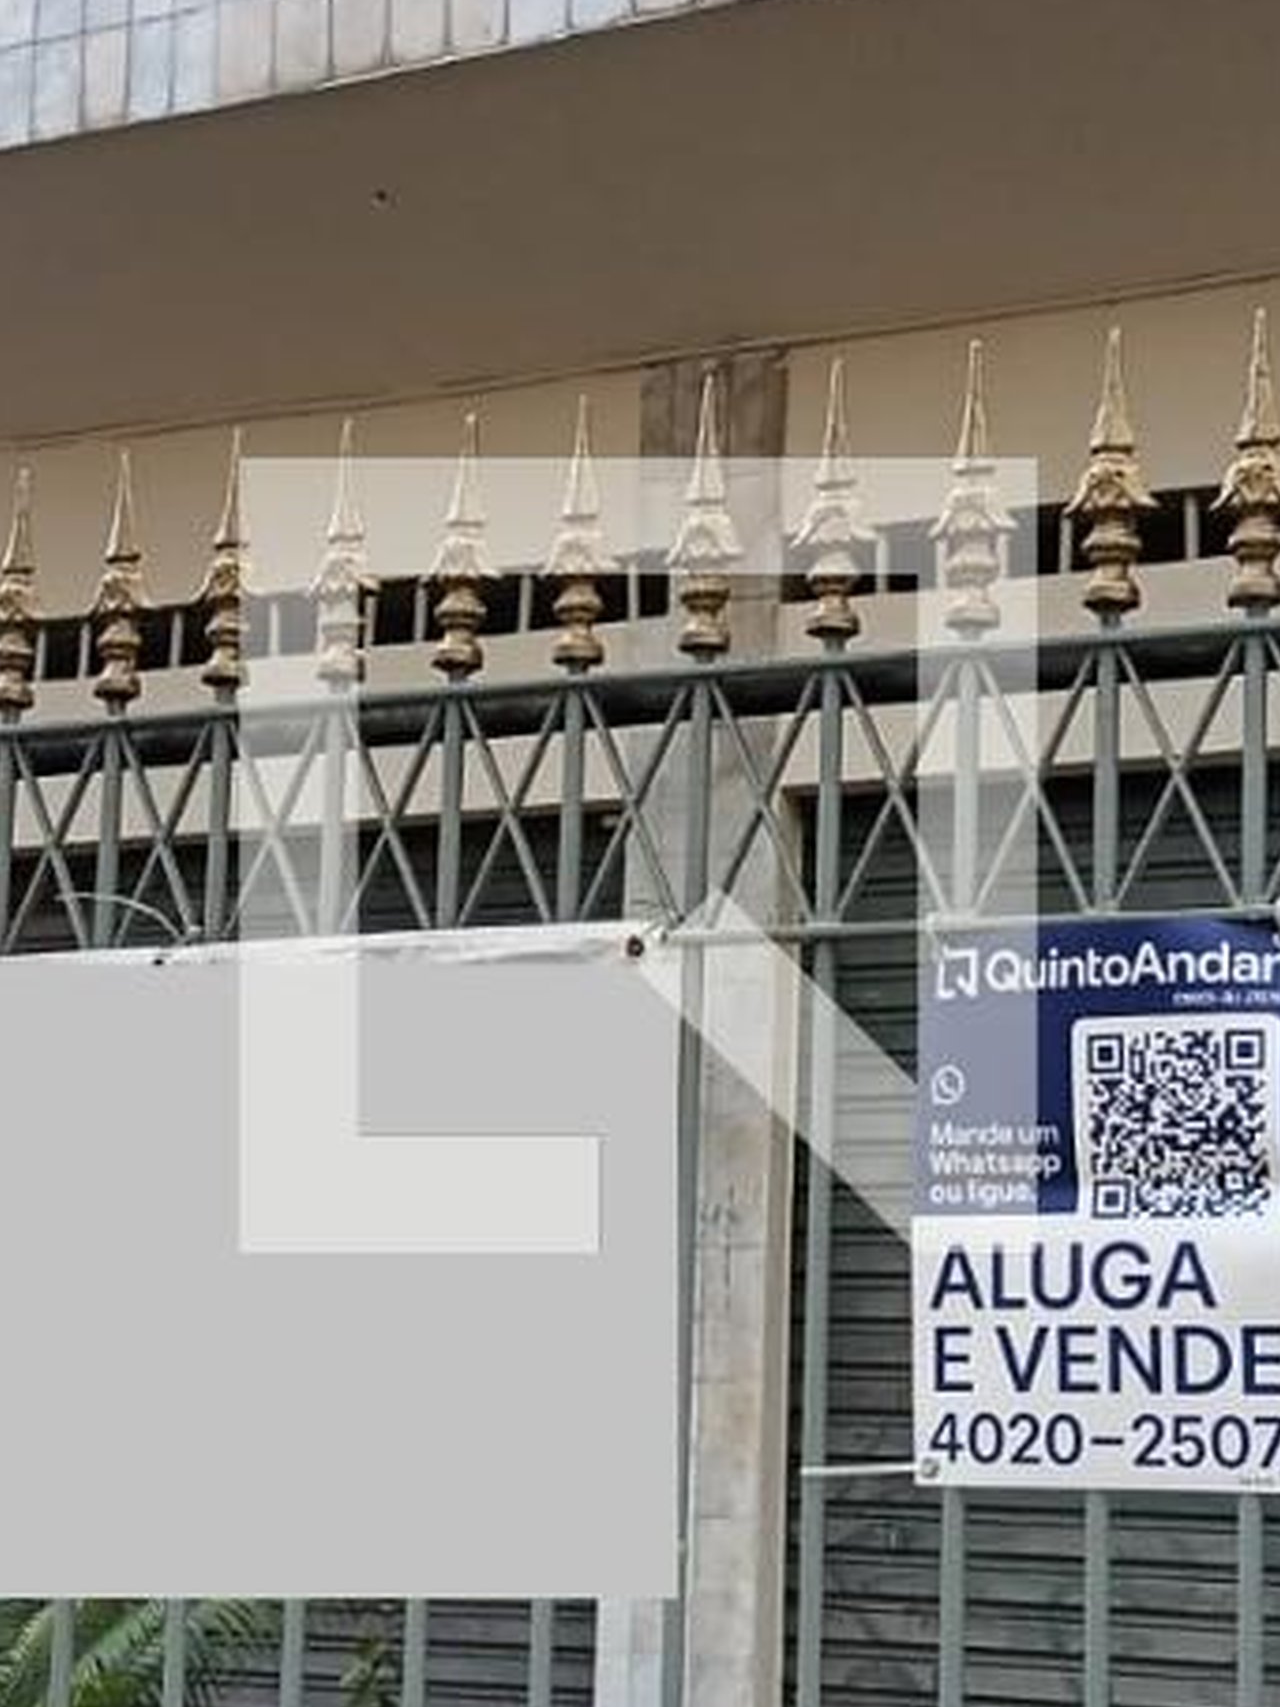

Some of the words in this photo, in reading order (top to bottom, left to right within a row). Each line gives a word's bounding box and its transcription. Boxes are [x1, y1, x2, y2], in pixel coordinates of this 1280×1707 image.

[1017, 1126, 1060, 1146] um
[929, 1183, 962, 1204] ou
[931, 1241, 1218, 1310] ALUGA
[933, 1325, 974, 1393] E
